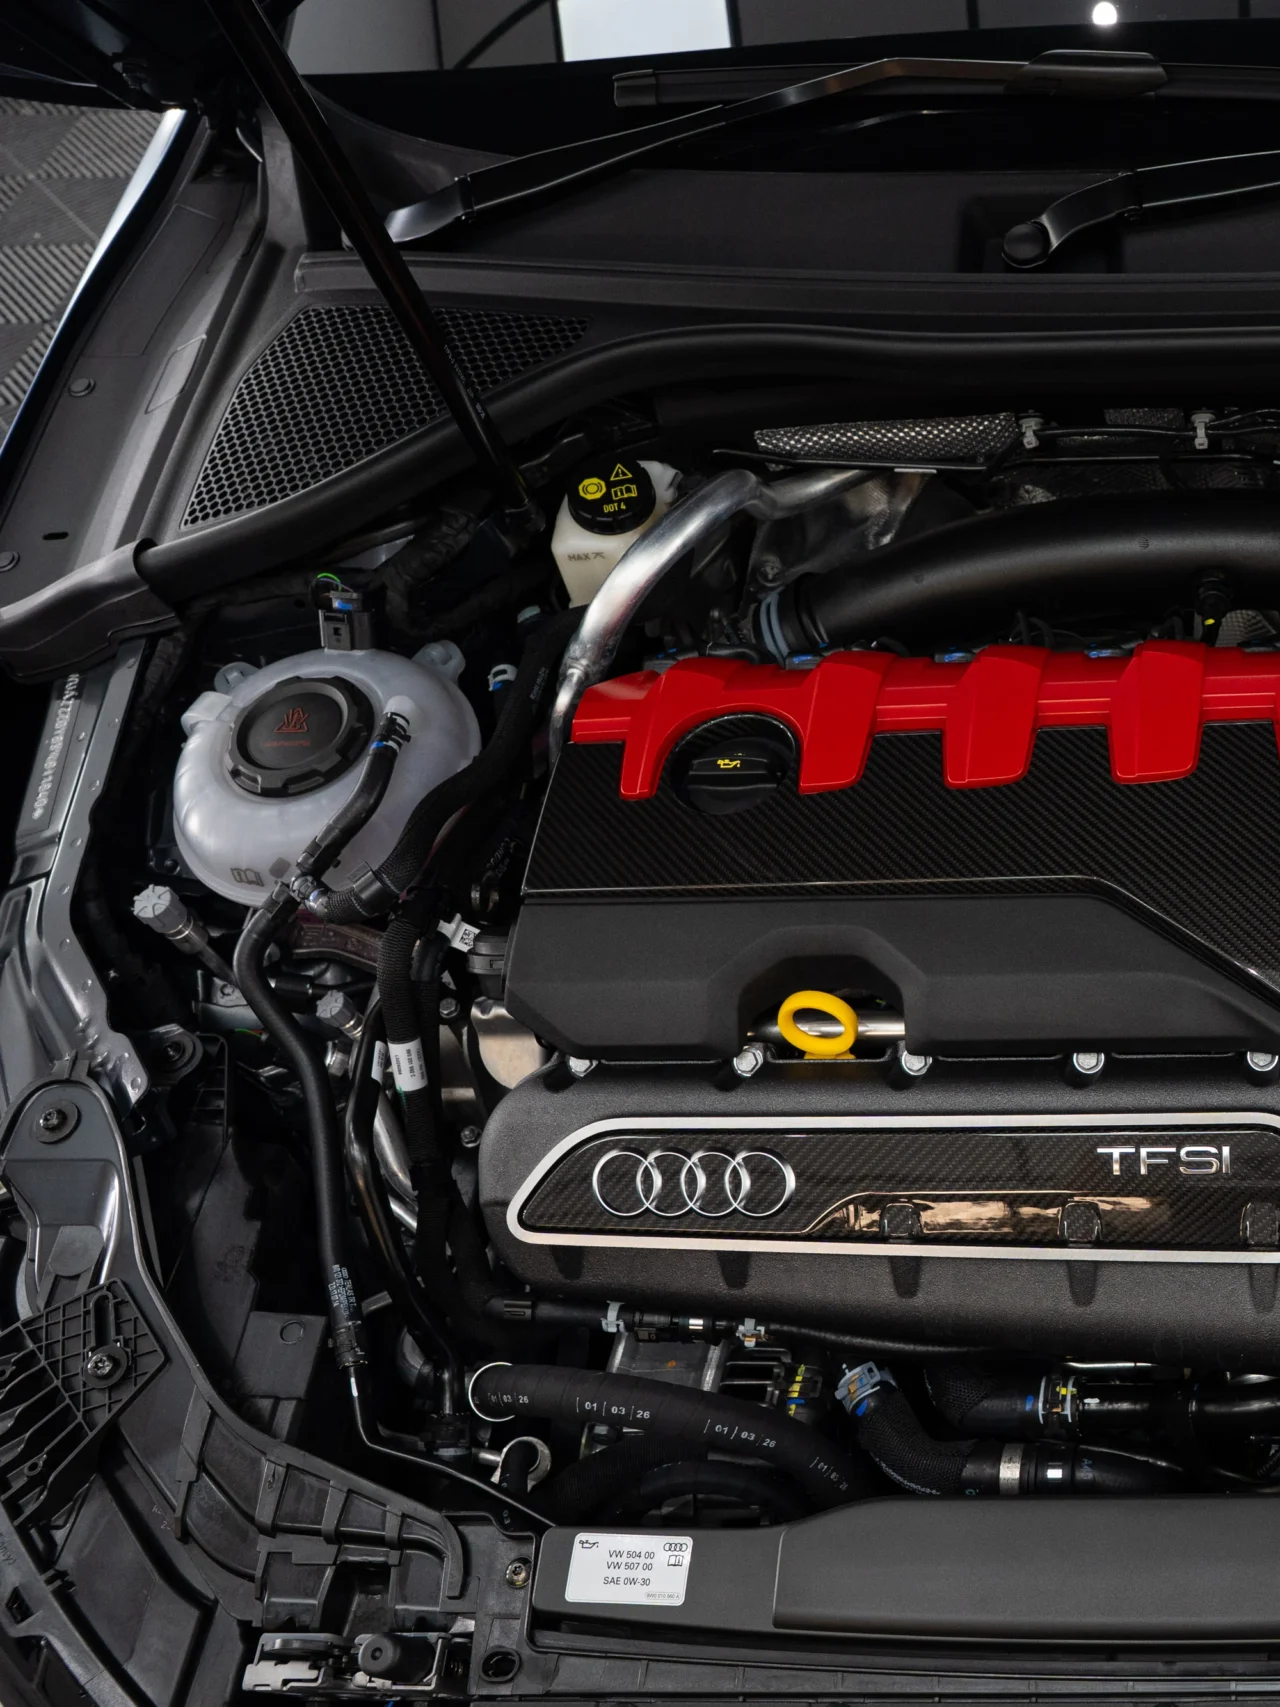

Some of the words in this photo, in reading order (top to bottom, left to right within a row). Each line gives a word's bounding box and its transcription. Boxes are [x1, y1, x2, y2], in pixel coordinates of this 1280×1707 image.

[603, 502, 618, 513] DOT
[620, 502, 626, 510] 4
[567, 552, 591, 561] MAX
[1097, 1146, 1231, 1175] TFSI
[503, 1395, 512, 1403] 03
[518, 1395, 529, 1404] 26
[584, 1402, 597, 1411] 01
[611, 1406, 626, 1415] 03
[636, 1410, 650, 1419] 26
[714, 1424, 729, 1435] 01
[740, 1431, 756, 1441] 03
[762, 1438, 777, 1448] 26
[817, 1462, 828, 1472] 01
[608, 1550, 624, 1558] VW
[626, 1550, 642, 1559] 504
[644, 1551, 655, 1559] 00
[606, 1562, 623, 1570] VW
[624, 1562, 640, 1570] 507
[642, 1563, 653, 1571] 00
[603, 1577, 621, 1585] SAE
[623, 1577, 651, 1586] 0W-30
